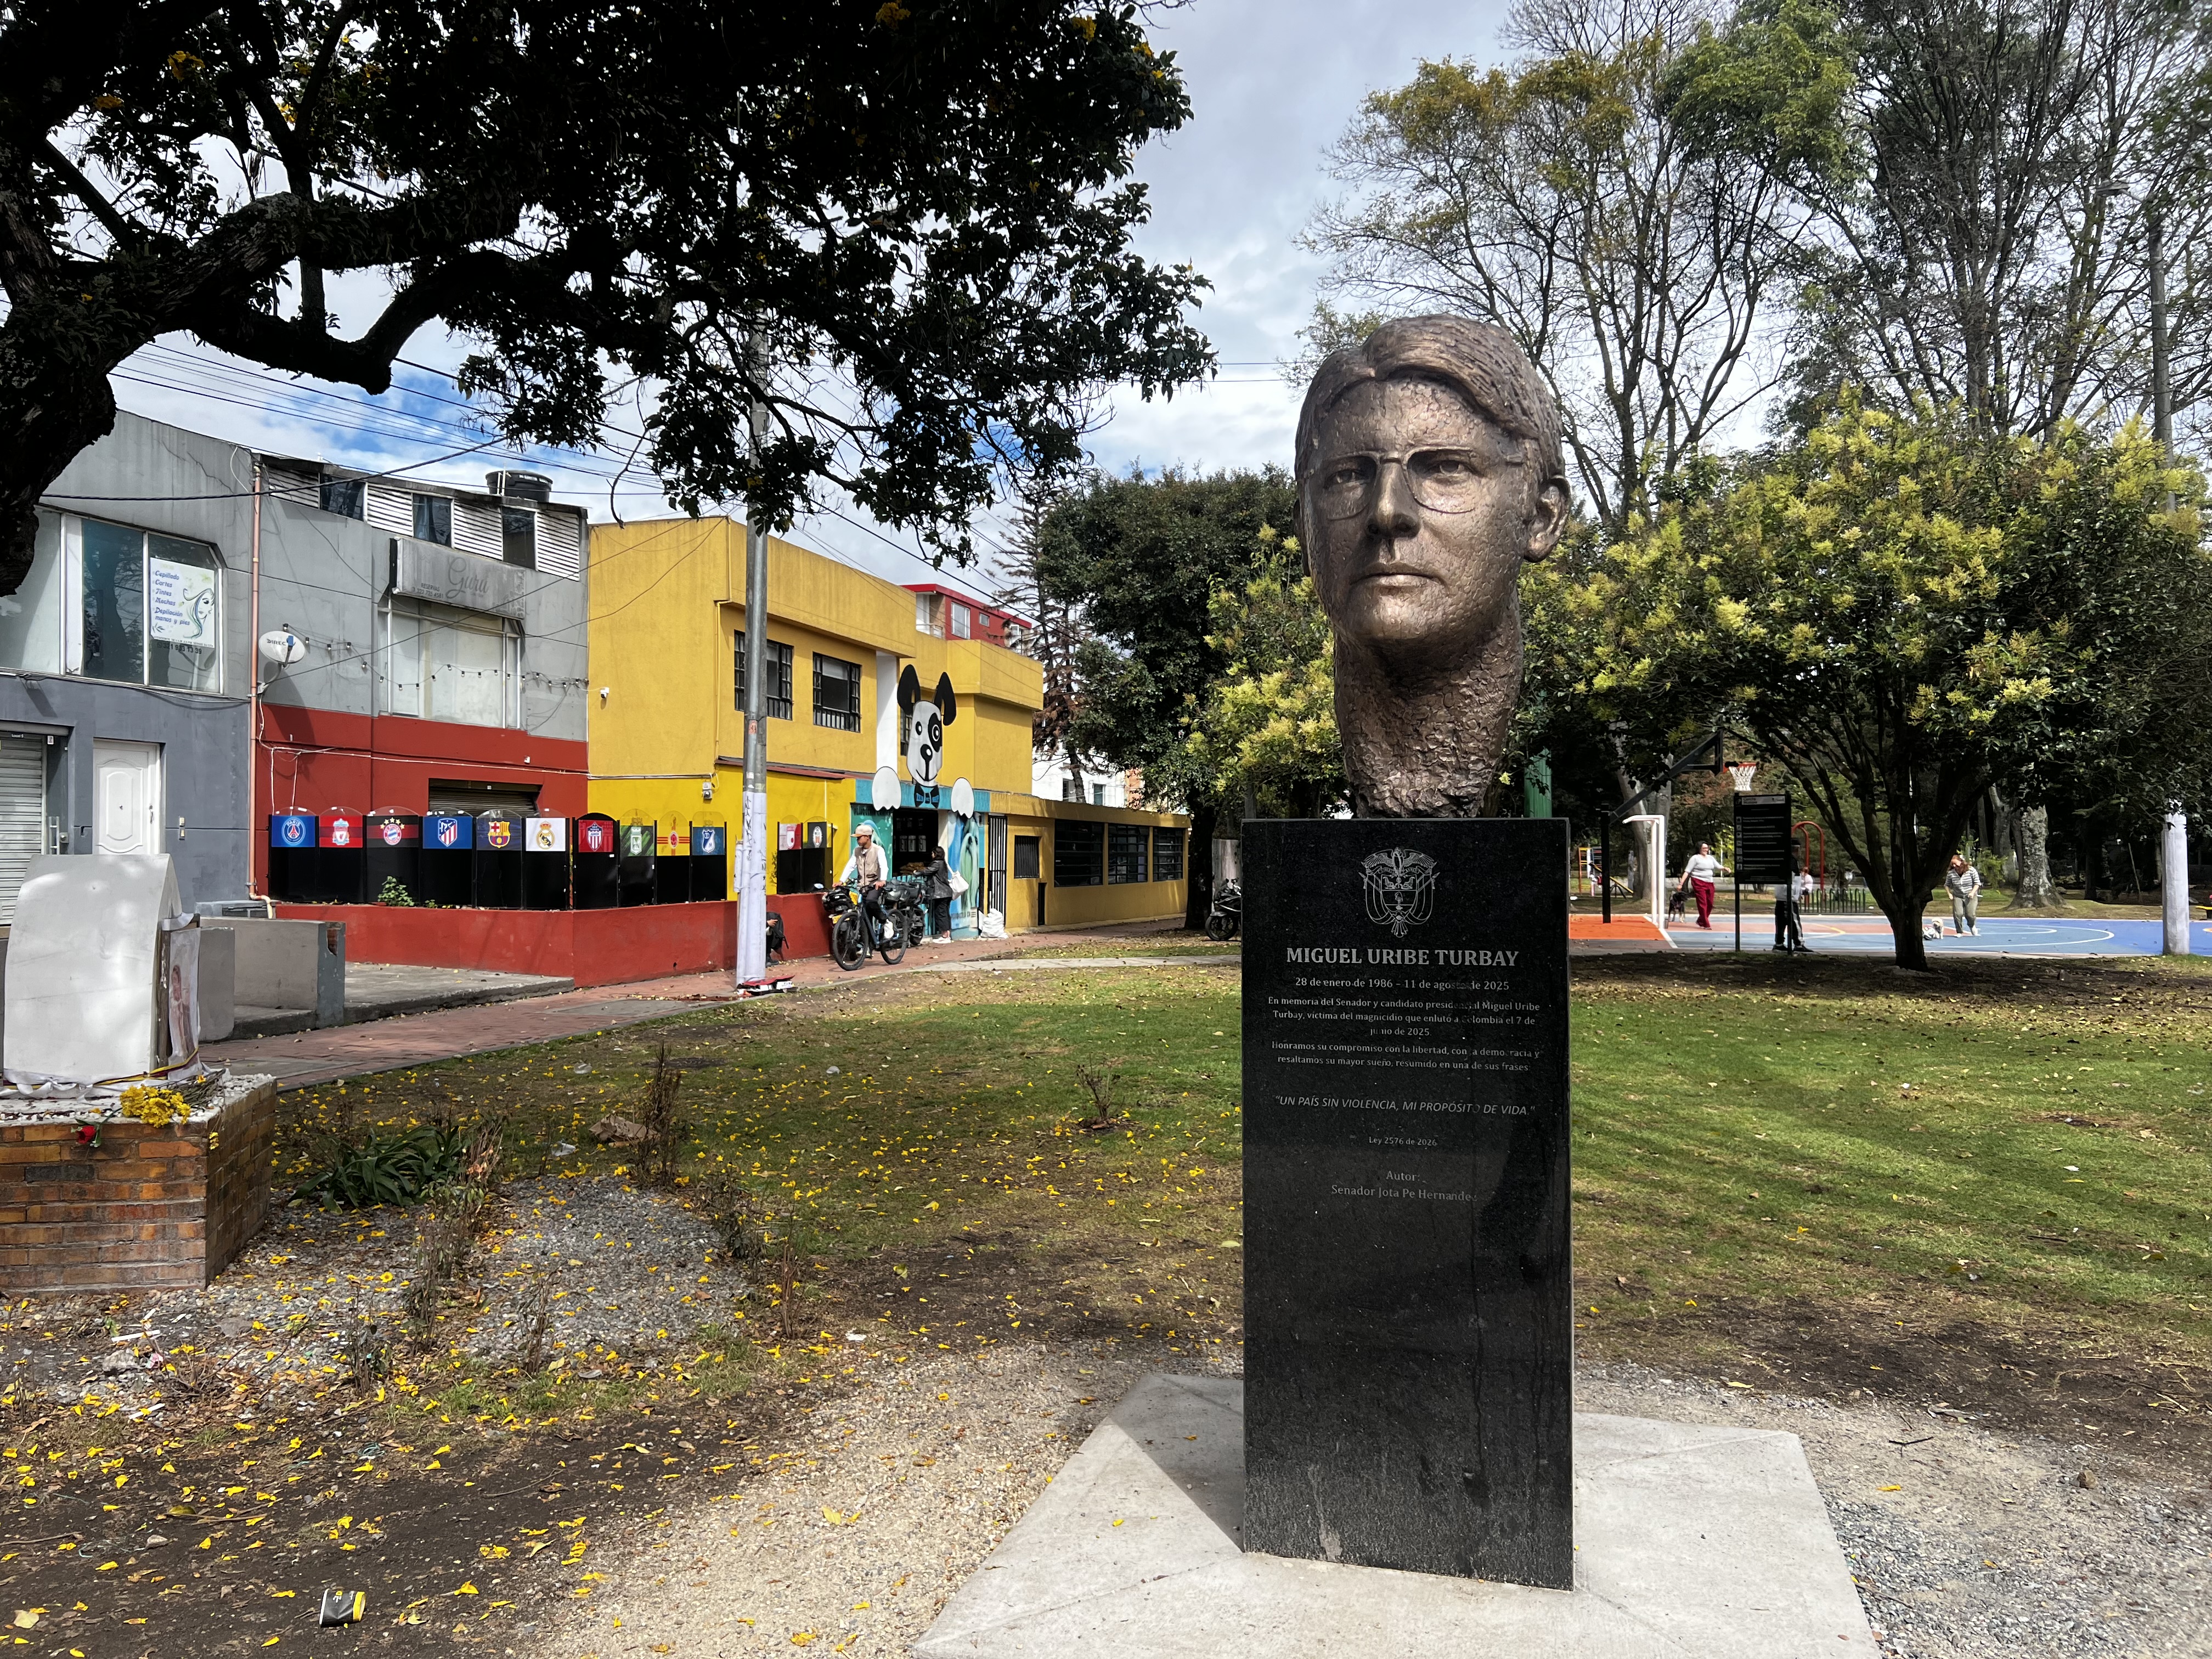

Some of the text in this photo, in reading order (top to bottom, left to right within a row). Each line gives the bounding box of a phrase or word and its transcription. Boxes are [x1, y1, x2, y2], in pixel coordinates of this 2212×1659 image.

[155, 579, 172, 588] Cortes
[266, 638, 296, 646] DIREC
[1286, 947, 1519, 966] MIGUEL URIBE TURBAY
[1295, 977, 1307, 986] 28
[1310, 978, 1322, 987] de
[1353, 978, 1365, 988] de
[1368, 979, 1393, 988] 1986
[1404, 979, 1415, 988] 11
[1419, 980, 1431, 989] de
[1483, 981, 1510, 991] 2025
[1268, 996, 1279, 1005] En
[1321, 998, 1334, 1006] del
[1336, 998, 1372, 1007] Senador
[1373, 1000, 1379, 1009] y
[1380, 998, 1424, 1008] candidato
[1482, 1001, 1513, 1012] Miguel
[1515, 1002, 1540, 1011] Uribe
[1273, 1010, 1305, 1020] Turbay,
[1340, 1012, 1353, 1020] del
[1355, 1012, 1403, 1023] magnicidio
[1405, 1015, 1421, 1024] que
[1505, 1016, 1514, 1024] el
[1516, 1017, 1522, 1025] 7
[1272, 1041, 1316, 1051] Honramos
[1329, 1045, 1383, 1053] compromiso
[1403, 1045, 1410, 1053] la
[1413, 1045, 1450, 1056] libertad,
[1534, 1051, 1540, 1059] y
[1278, 1055, 1324, 1064] resaltamos
[1338, 1059, 1365, 1067] mayor
[1396, 1059, 1437, 1069] resumido
[1471, 1061, 1482, 1070] de
[1298, 1094, 1320, 1107] PAÍS
[1322, 1098, 1340, 1108] SIN
[1342, 1098, 1398, 1111] VIOLENCIA,
[1402, 1101, 1417, 1110] MI
[1419, 1100, 1481, 1113] PROPÓSITO
[1483, 1104, 1498, 1114] DE
[1369, 1136, 1383, 1146] Ley
[1384, 1137, 1404, 1145] 2576
[1417, 1138, 1437, 1146] 2026
[1386, 1170, 1421, 1181] Autor:
[1331, 1184, 1375, 1197] Senador
[1378, 1187, 1400, 1199] Jota
[1402, 1188, 1415, 1198] Pe
